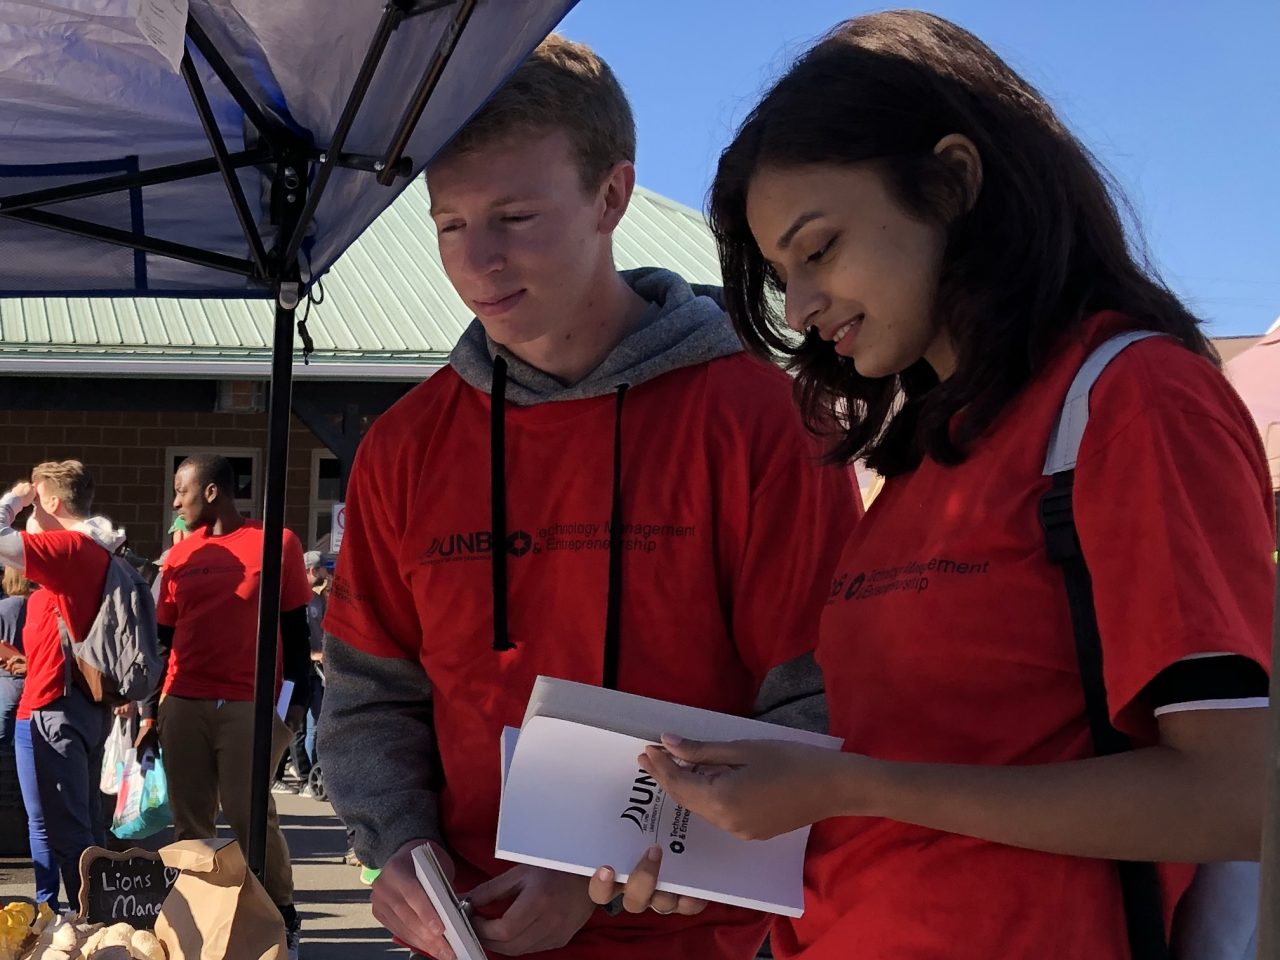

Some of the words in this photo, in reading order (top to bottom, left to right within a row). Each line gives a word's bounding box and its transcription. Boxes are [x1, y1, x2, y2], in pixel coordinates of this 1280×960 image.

[537, 521, 599, 539] echnology
[604, 522, 696, 539] Mnagement
[545, 536, 658, 553] Entrepreneship
[629, 768, 657, 806] UN
[101, 871, 152, 891] Lions
[111, 894, 162, 919] Mane
